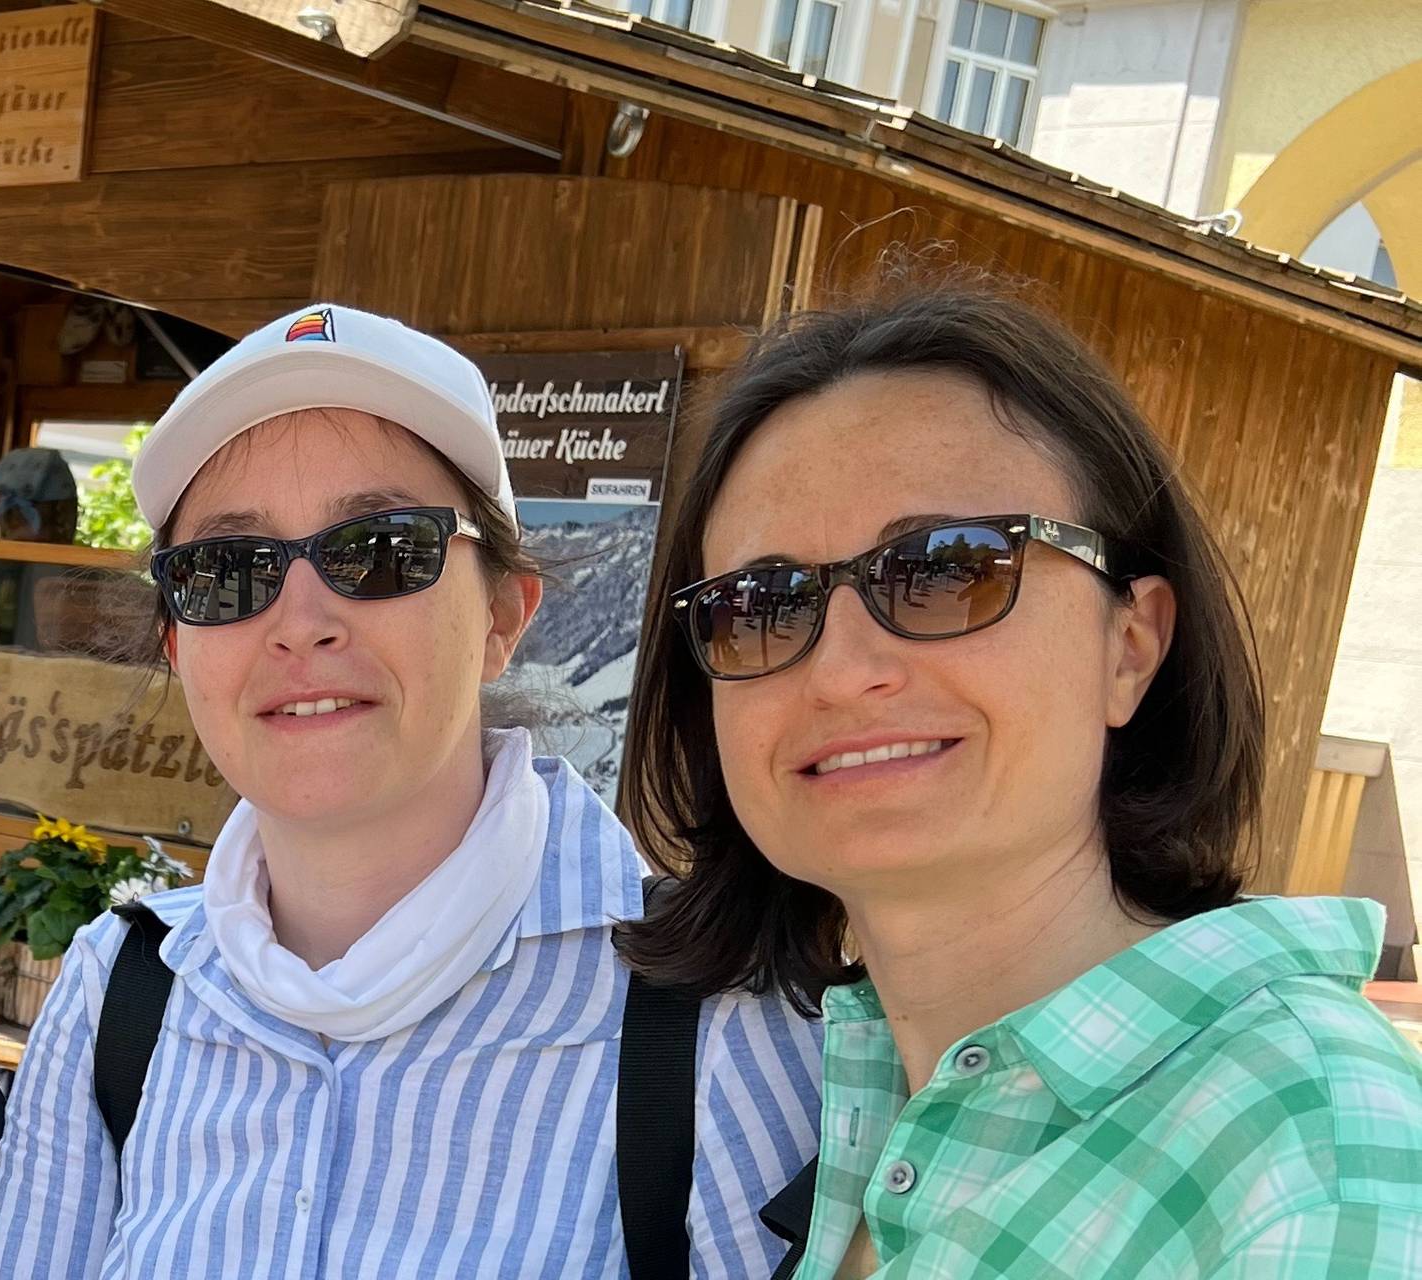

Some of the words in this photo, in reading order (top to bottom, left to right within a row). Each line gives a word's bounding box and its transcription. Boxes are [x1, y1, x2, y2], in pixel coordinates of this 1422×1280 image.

[489, 380, 670, 419] lpdorfschmakerl
[500, 429, 555, 460] äuer
[555, 427, 628, 465] Küche
[590, 483, 647, 496] SKIFAHREN
